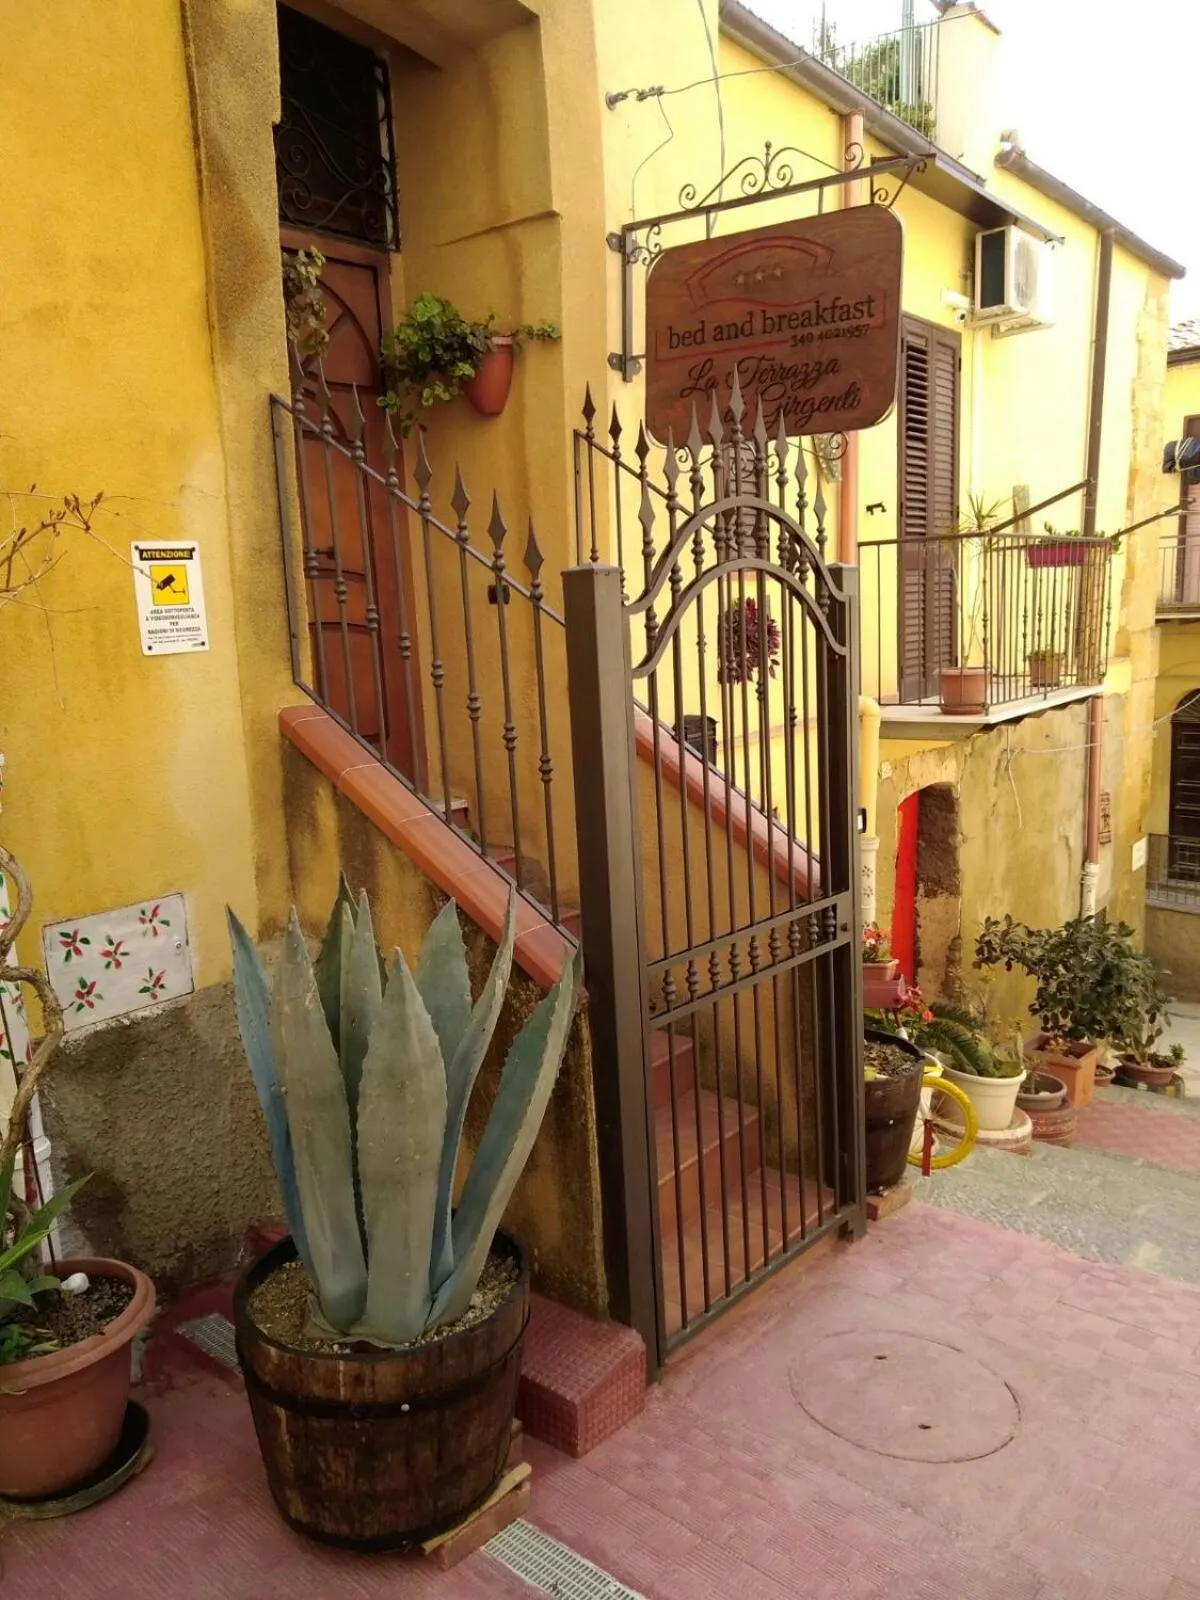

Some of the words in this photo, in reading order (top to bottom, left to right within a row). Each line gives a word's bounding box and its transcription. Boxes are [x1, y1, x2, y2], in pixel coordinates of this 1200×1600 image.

[668, 319, 706, 349] bed
[713, 312, 754, 342] and
[762, 296, 875, 334] breakfast
[790, 331, 814, 348] 340
[680, 358, 720, 400] La
[726, 354, 840, 392] Terrazza
